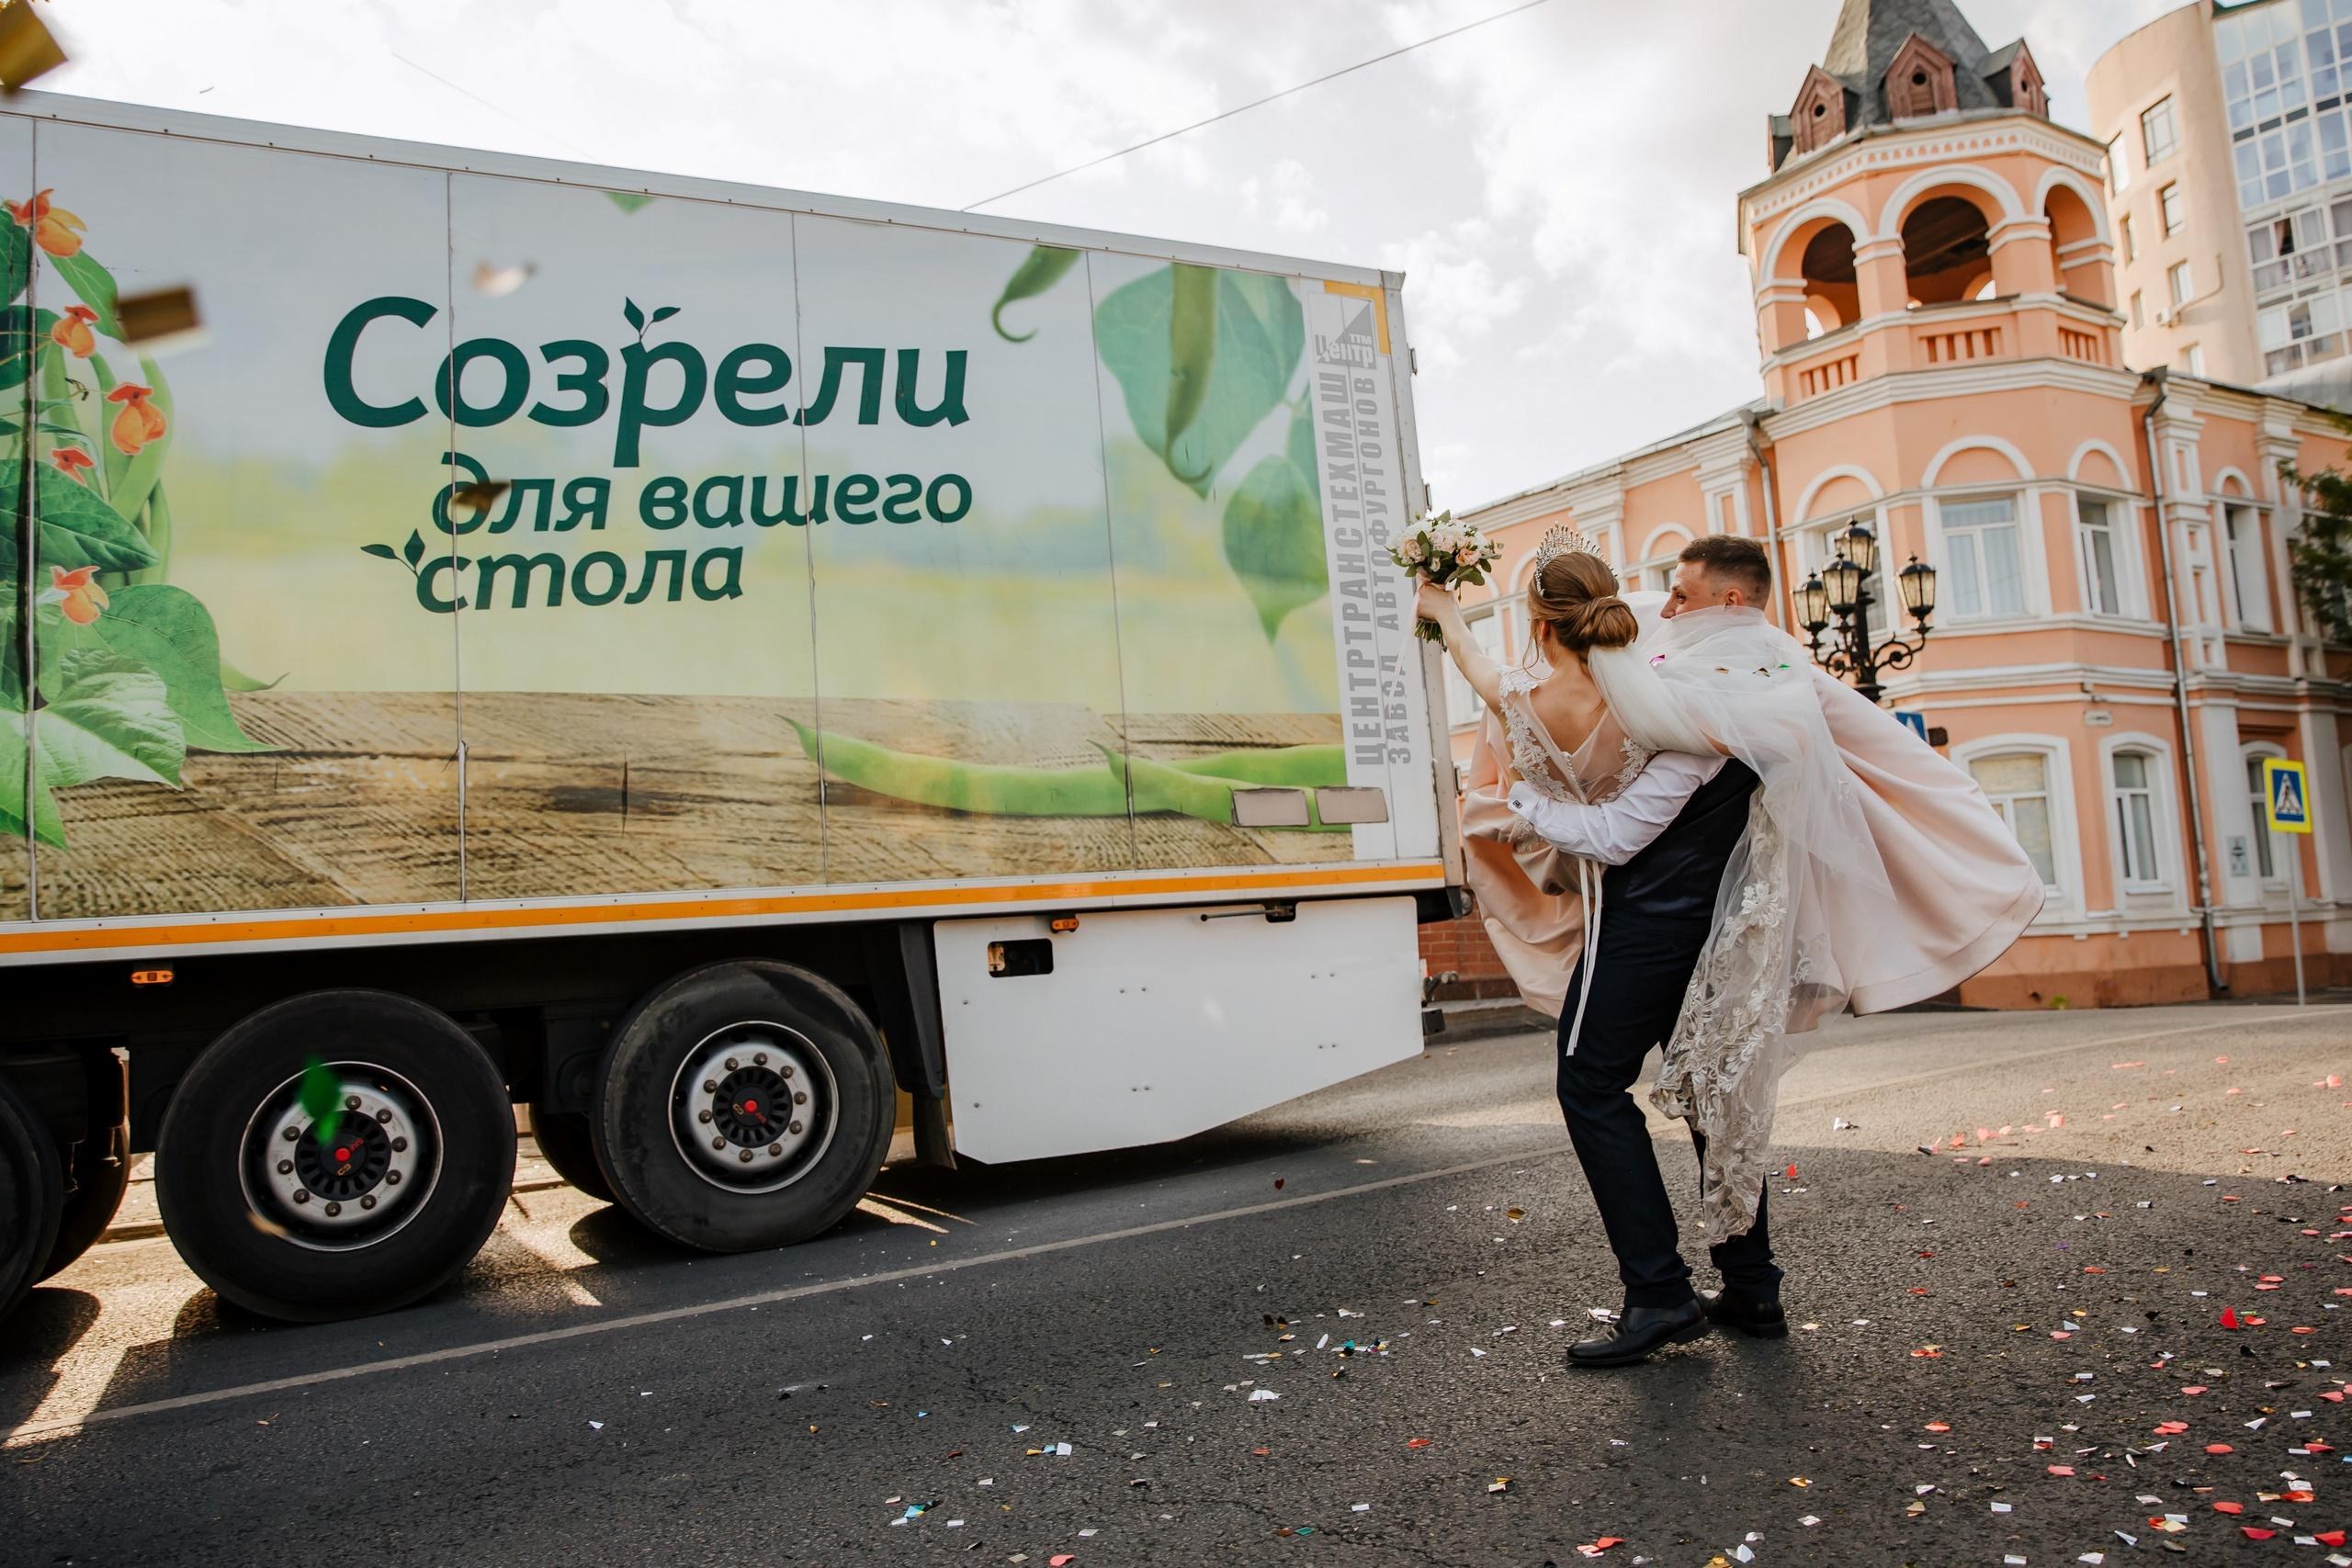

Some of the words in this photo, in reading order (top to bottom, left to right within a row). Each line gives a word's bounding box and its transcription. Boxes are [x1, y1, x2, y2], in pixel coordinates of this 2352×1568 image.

[324, 296, 970, 468] Созрели
[432, 451, 612, 535] для
[639, 473, 973, 529] вашего
[1354, 377, 1399, 632] АВТОФУРГОНОВ
[416, 546, 744, 614] стола
[1319, 372, 1386, 765] ЦЕНТРТРАНСТЕХМАШ
[1381, 655, 1411, 764] ЗАВОД
